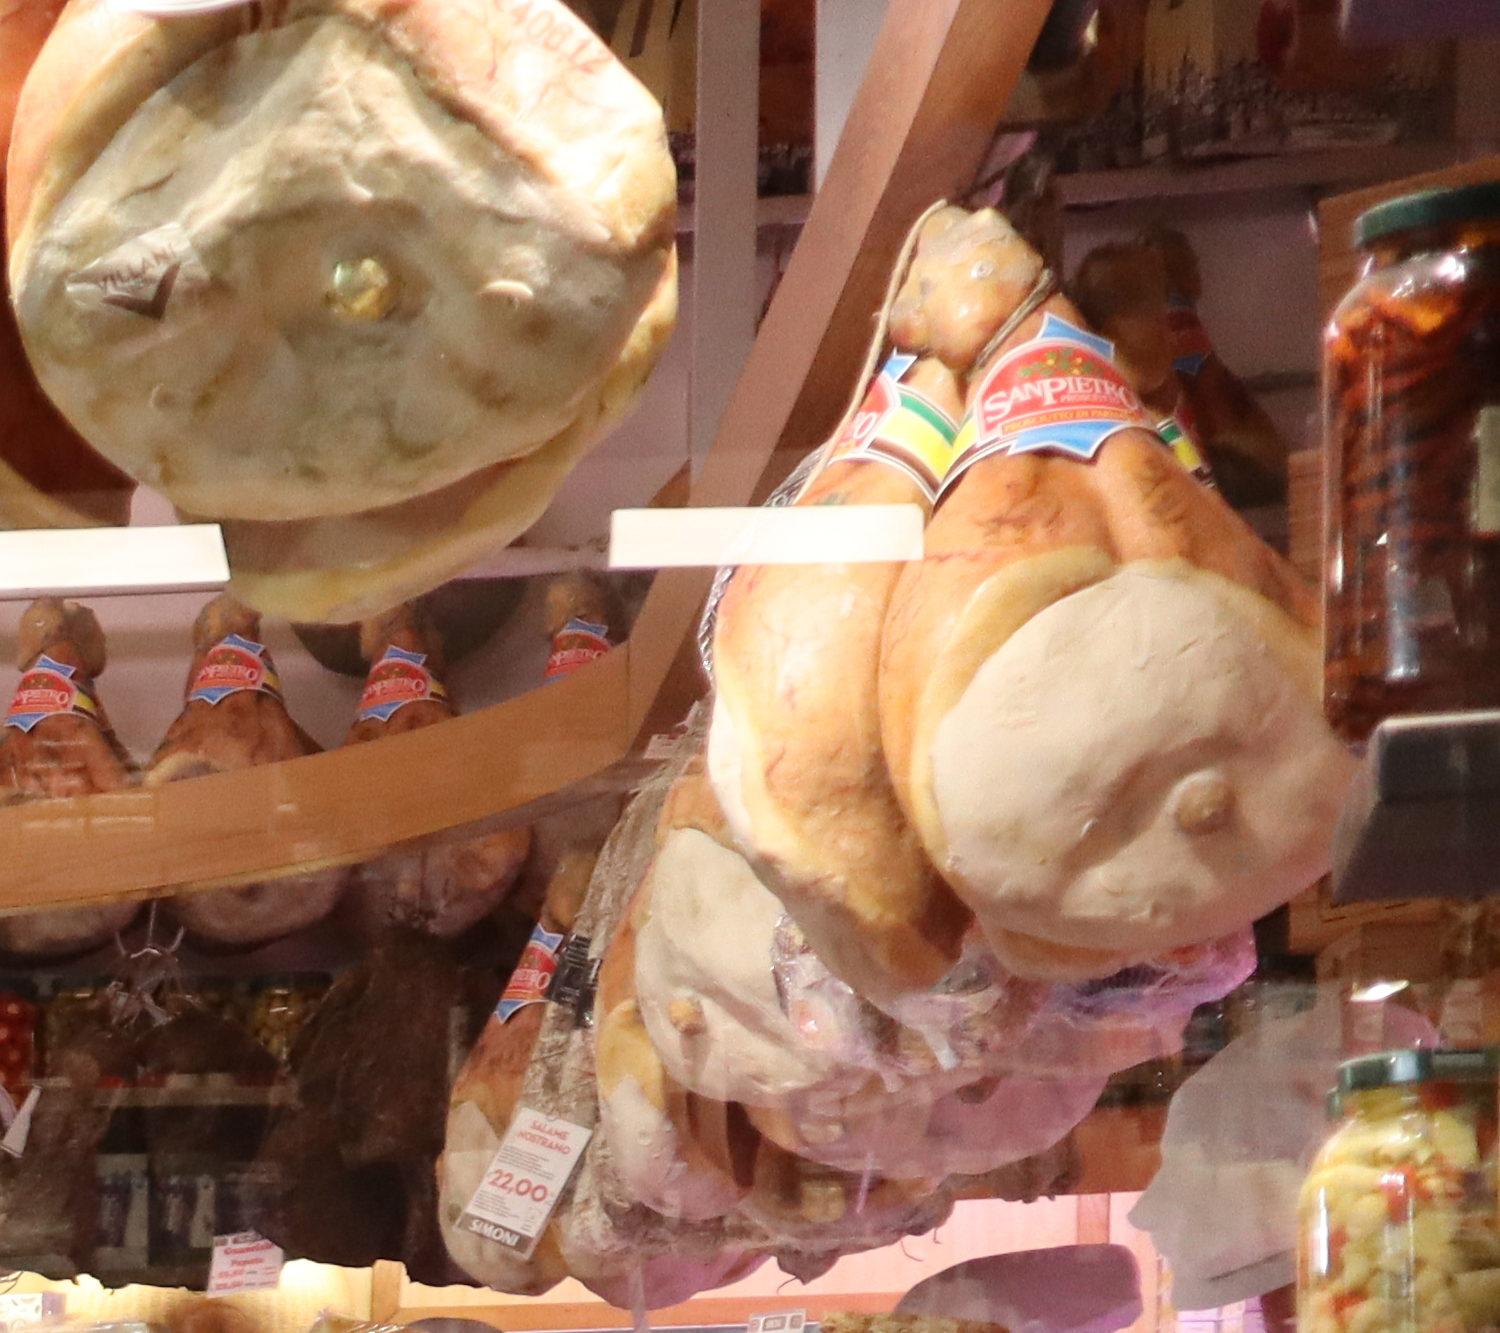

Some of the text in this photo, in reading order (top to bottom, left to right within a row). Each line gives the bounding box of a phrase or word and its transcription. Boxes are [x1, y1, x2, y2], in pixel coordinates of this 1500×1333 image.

[531, 1120, 570, 1141] SALAME
[489, 1169, 548, 1202] 22,00
[469, 1219, 519, 1247] SIMONI
